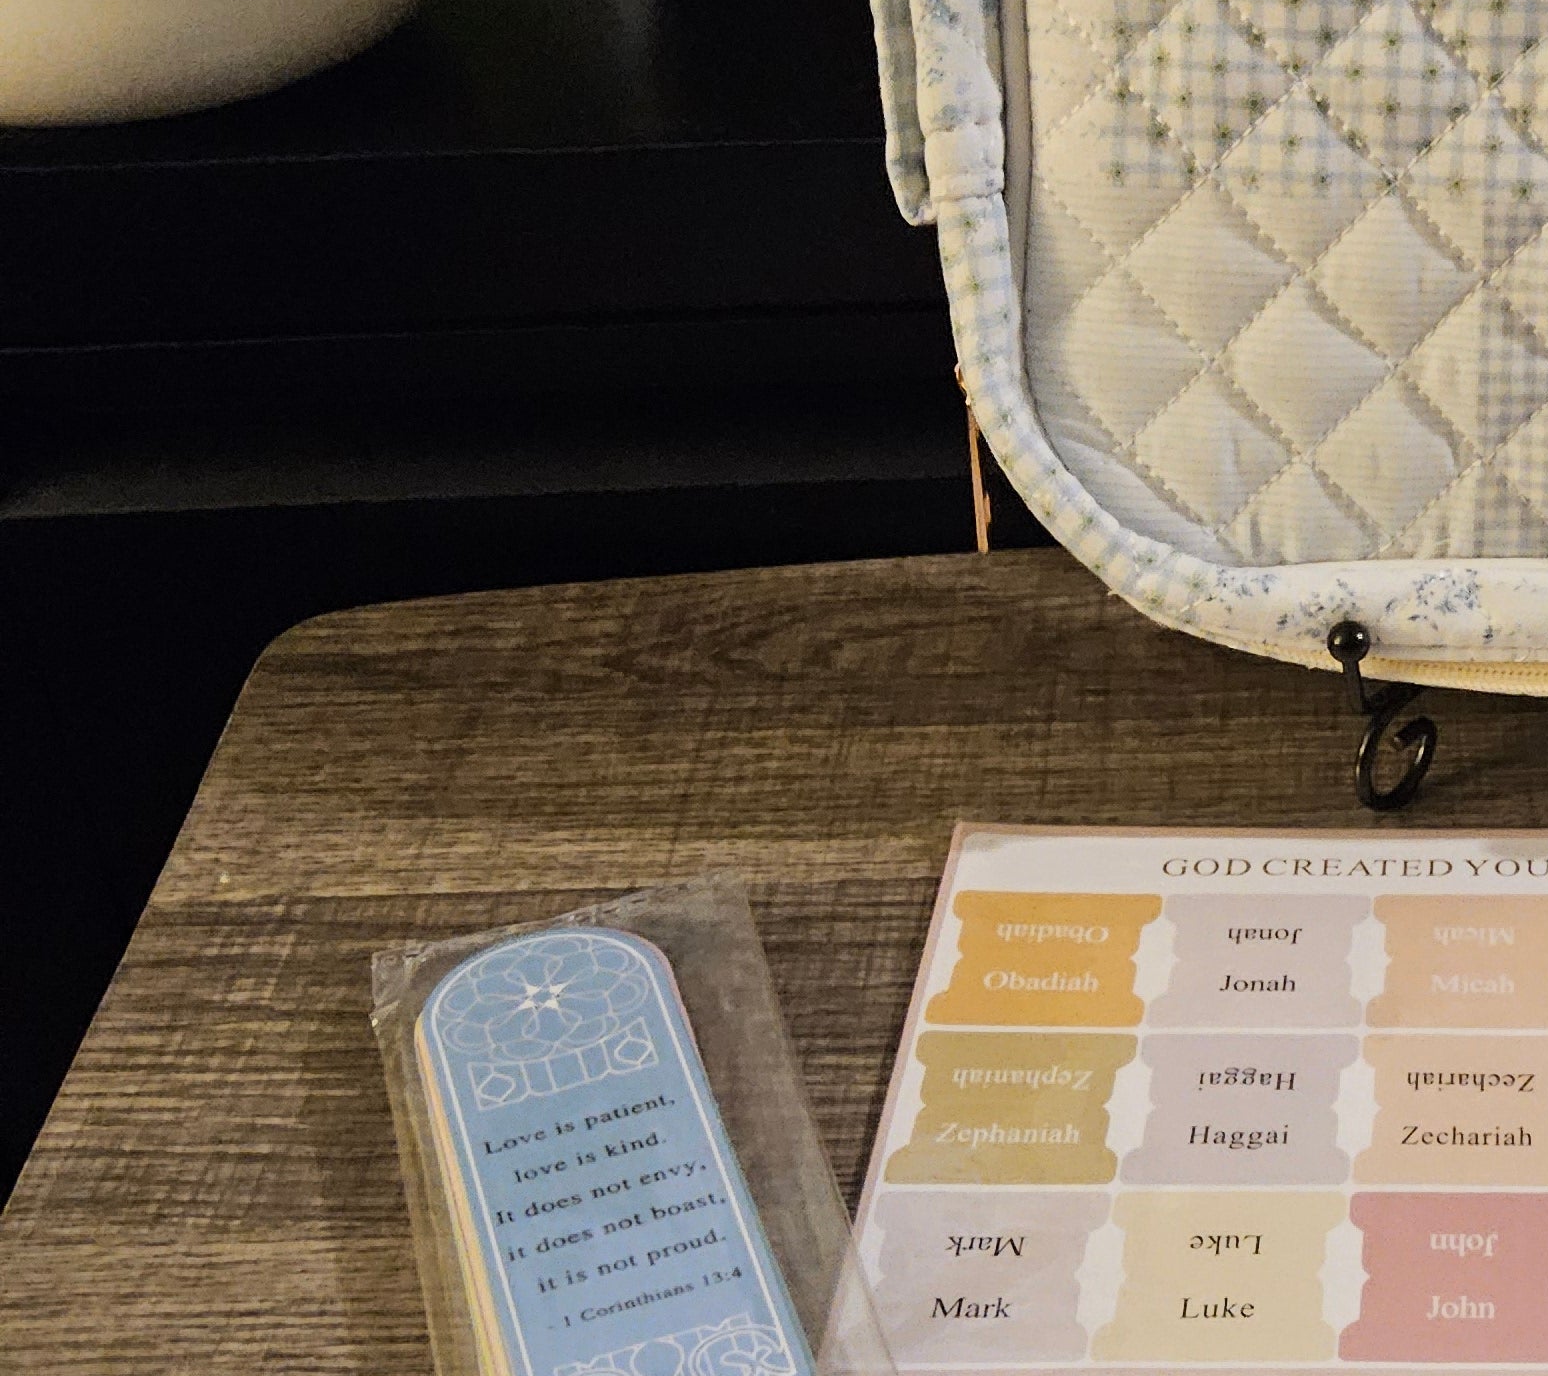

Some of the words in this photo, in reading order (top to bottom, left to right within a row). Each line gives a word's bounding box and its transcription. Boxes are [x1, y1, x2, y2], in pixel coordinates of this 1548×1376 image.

[1162, 858, 1251, 877] GOD
[1262, 858, 1454, 877] CREATED
[997, 923, 1109, 944] Obadiah
[1227, 927, 1302, 946] Jonah
[983, 970, 1100, 993] Obadiah
[1218, 974, 1296, 994] Jonah
[953, 1068, 1093, 1092] Zephaniah
[1199, 1067, 1297, 1092] Haggai
[1407, 1070, 1537, 1093] Zechariah
[484, 1130, 547, 1155] Love
[555, 1122, 575, 1136] is
[584, 1094, 676, 1130] patient,
[936, 1122, 1081, 1148] Zephaniah
[1401, 1125, 1534, 1148] Zechariah
[1188, 1125, 1290, 1149] Haggai
[513, 1160, 567, 1183] love
[576, 1151, 597, 1166] is
[496, 1210, 514, 1225] It
[524, 1193, 583, 1218] does
[590, 1179, 633, 1200] not
[508, 1246, 528, 1262] it
[535, 1229, 594, 1254] does
[603, 1213, 644, 1235] not
[946, 1235, 1026, 1257] Mark
[1189, 1234, 1263, 1256] Luke
[1429, 1233, 1500, 1258] John
[536, 1277, 558, 1293] it
[566, 1270, 588, 1285] is
[597, 1255, 638, 1276] not
[647, 1228, 727, 1266] proud.
[579, 1281, 696, 1322] Corinthians
[702, 1266, 743, 1287] 13:4
[931, 1296, 1012, 1320] Mark
[1180, 1296, 1256, 1320] Luke
[1426, 1294, 1496, 1320] John
